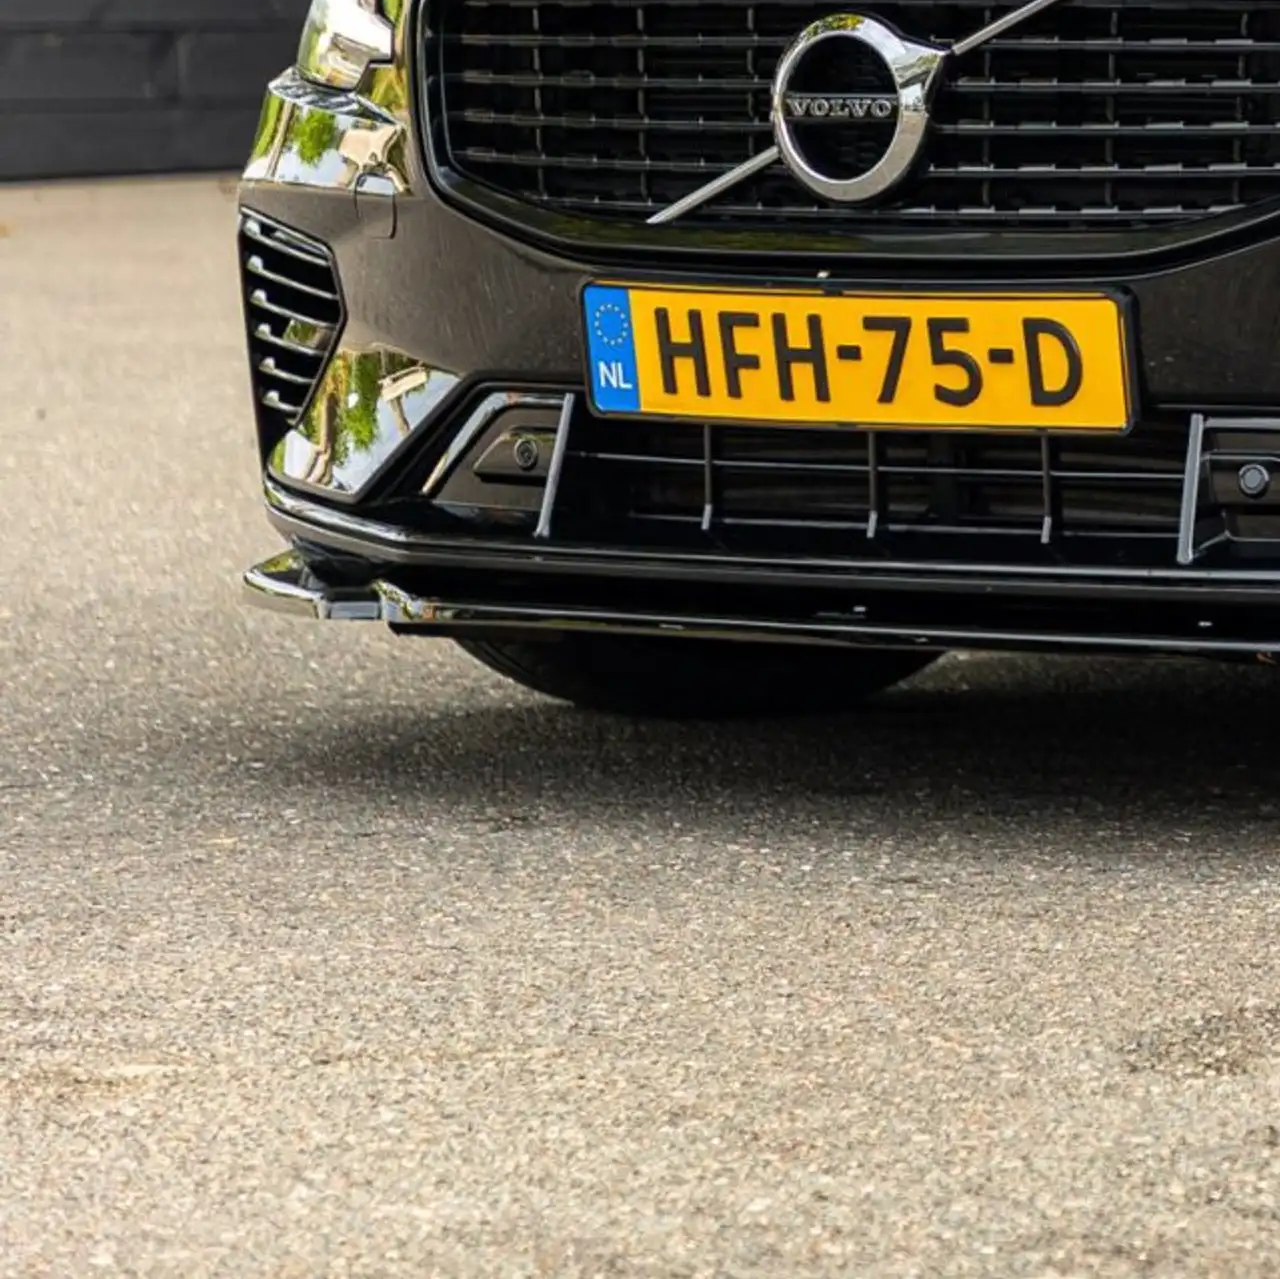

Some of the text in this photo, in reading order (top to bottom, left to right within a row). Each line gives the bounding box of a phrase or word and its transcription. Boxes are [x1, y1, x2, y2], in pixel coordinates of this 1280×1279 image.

[786, 98, 893, 118] VOLVO
[599, 307, 1083, 407] NL HFH-75-D
